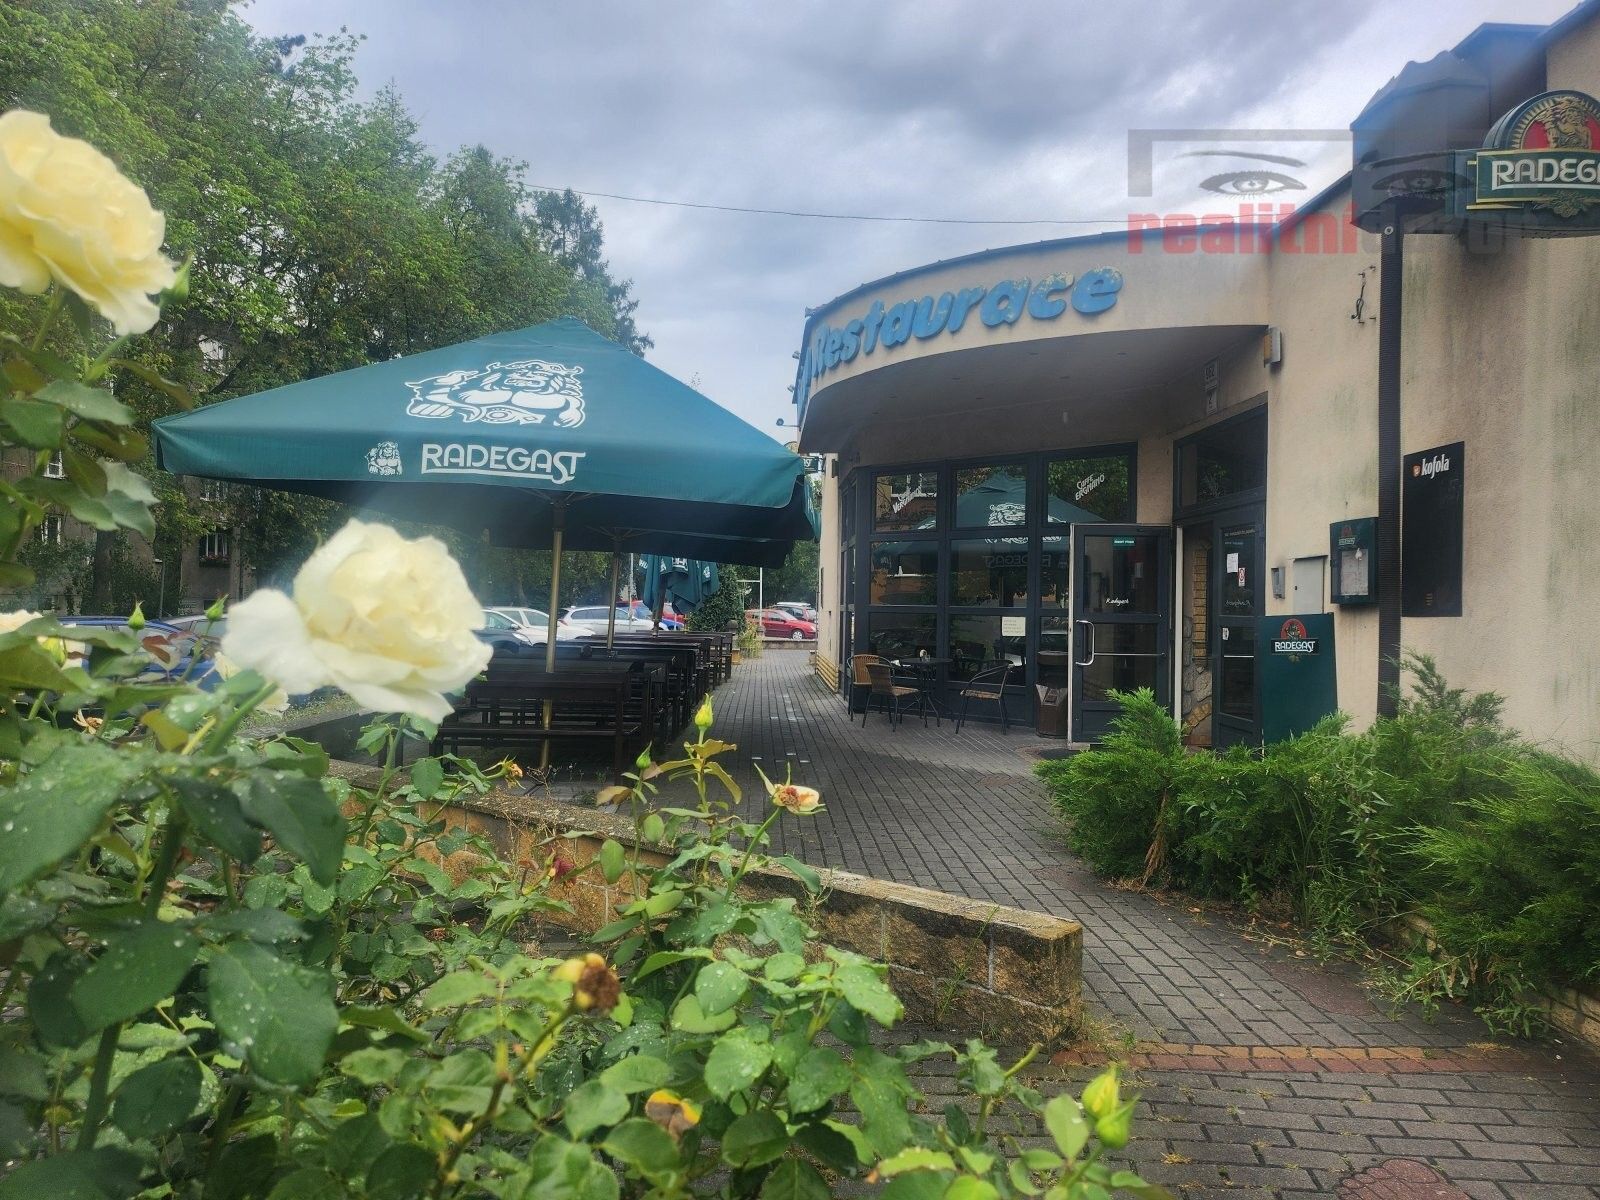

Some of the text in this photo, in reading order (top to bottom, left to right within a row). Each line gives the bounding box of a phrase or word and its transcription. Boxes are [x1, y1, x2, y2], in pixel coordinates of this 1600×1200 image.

[1491, 158, 1600, 190] RADEG
[810, 266, 1124, 380] Restaurace
[421, 443, 586, 484] RADEGAST
[1421, 453, 1450, 479] kofola
[1274, 641, 1316, 653] RADEGAST
